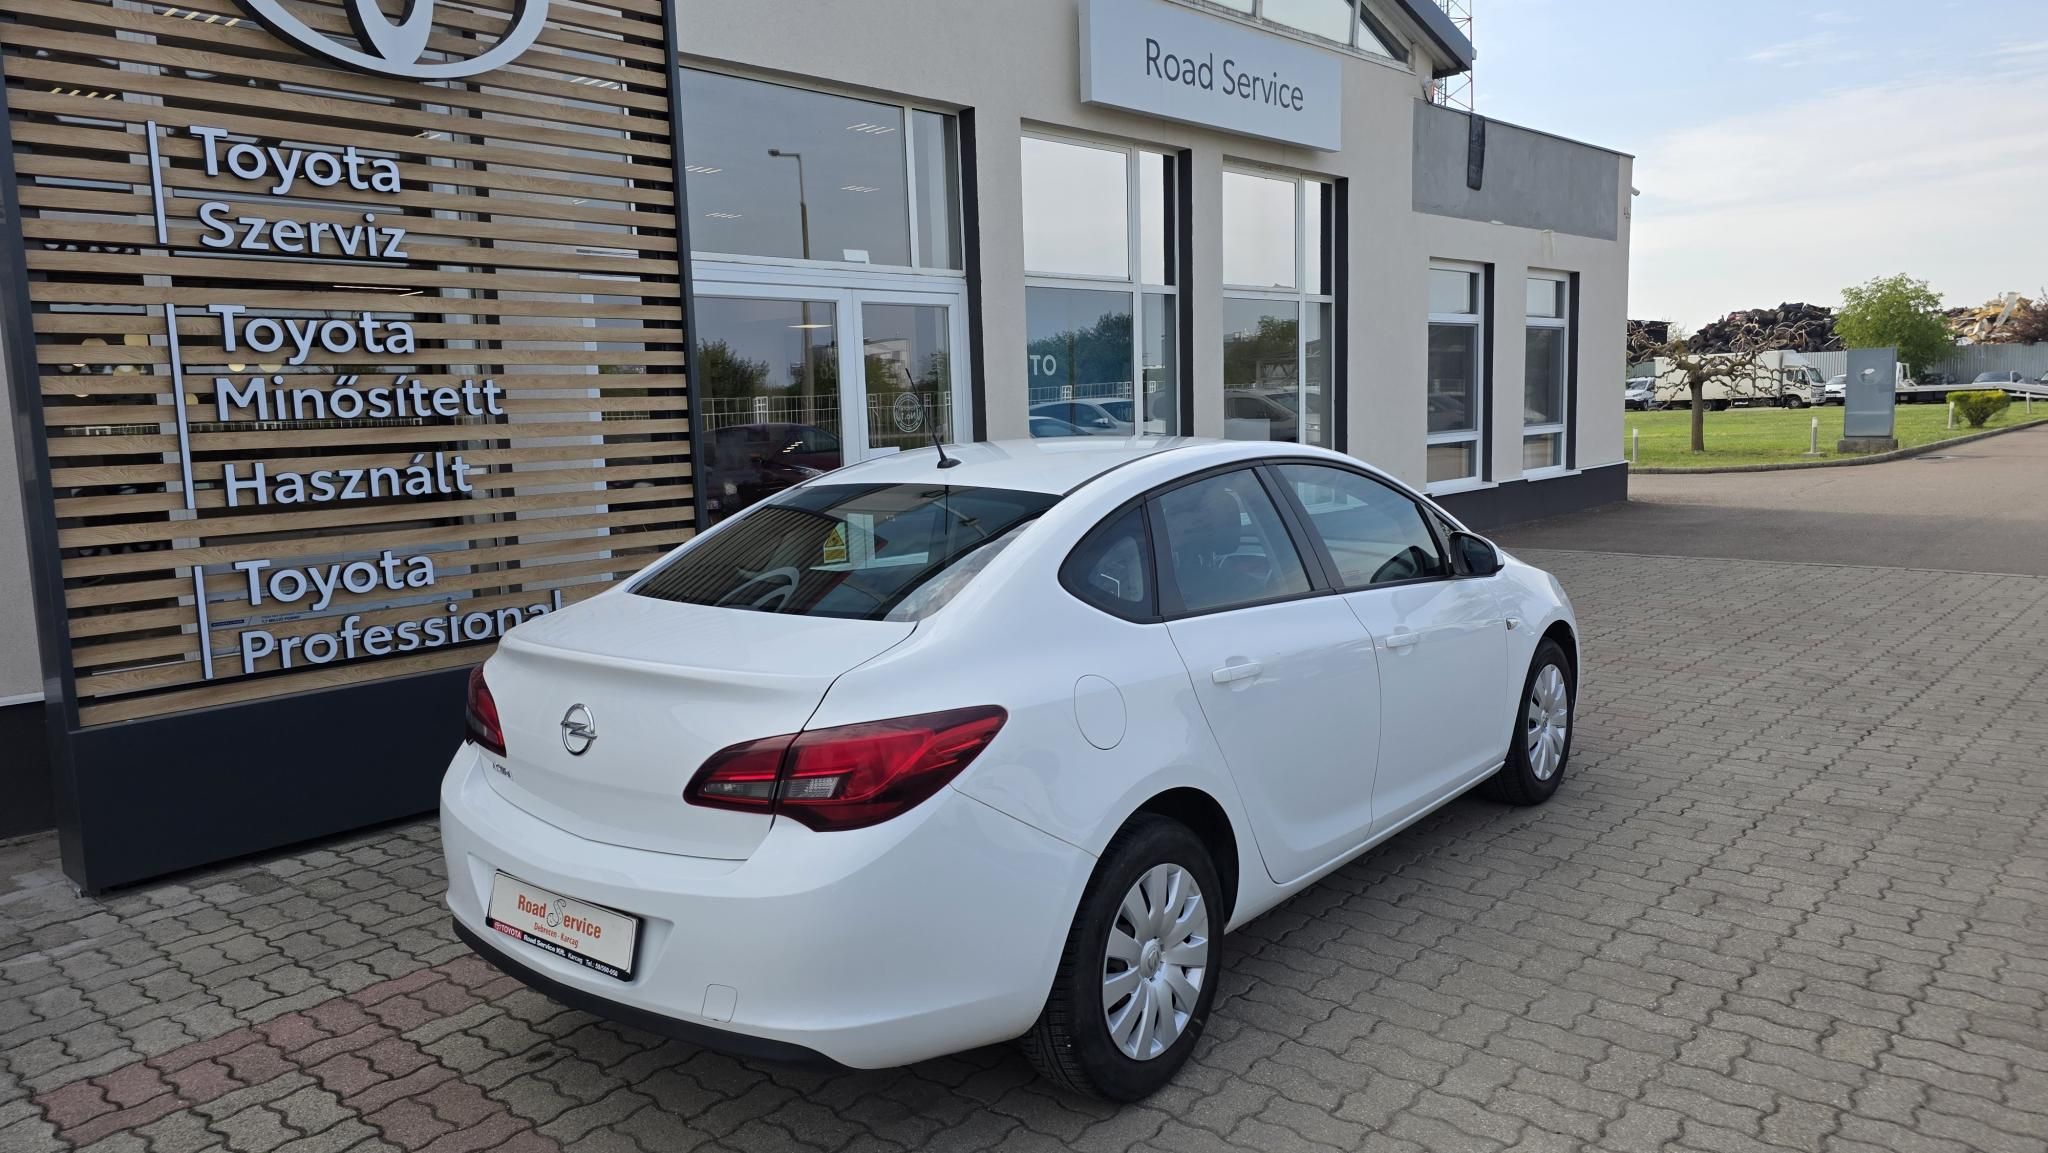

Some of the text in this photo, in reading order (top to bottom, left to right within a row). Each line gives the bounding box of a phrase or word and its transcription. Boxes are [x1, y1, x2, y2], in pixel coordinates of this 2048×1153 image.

[1145, 37, 1304, 111] Road Service
[189, 125, 401, 195] Toyota
[199, 201, 409, 258] Szerviz
[207, 304, 415, 366] Toyota
[214, 375, 504, 422] Minősített
[223, 451, 473, 507] Használt
[232, 550, 435, 611] Toyota
[501, 924, 522, 940] TOYOTA
[517, 894, 602, 939] Road Service
[523, 934, 537, 944] Road
[536, 940, 556, 953] Service
[533, 922, 558, 938] Debrecen
[560, 933, 579, 948] Karcag
